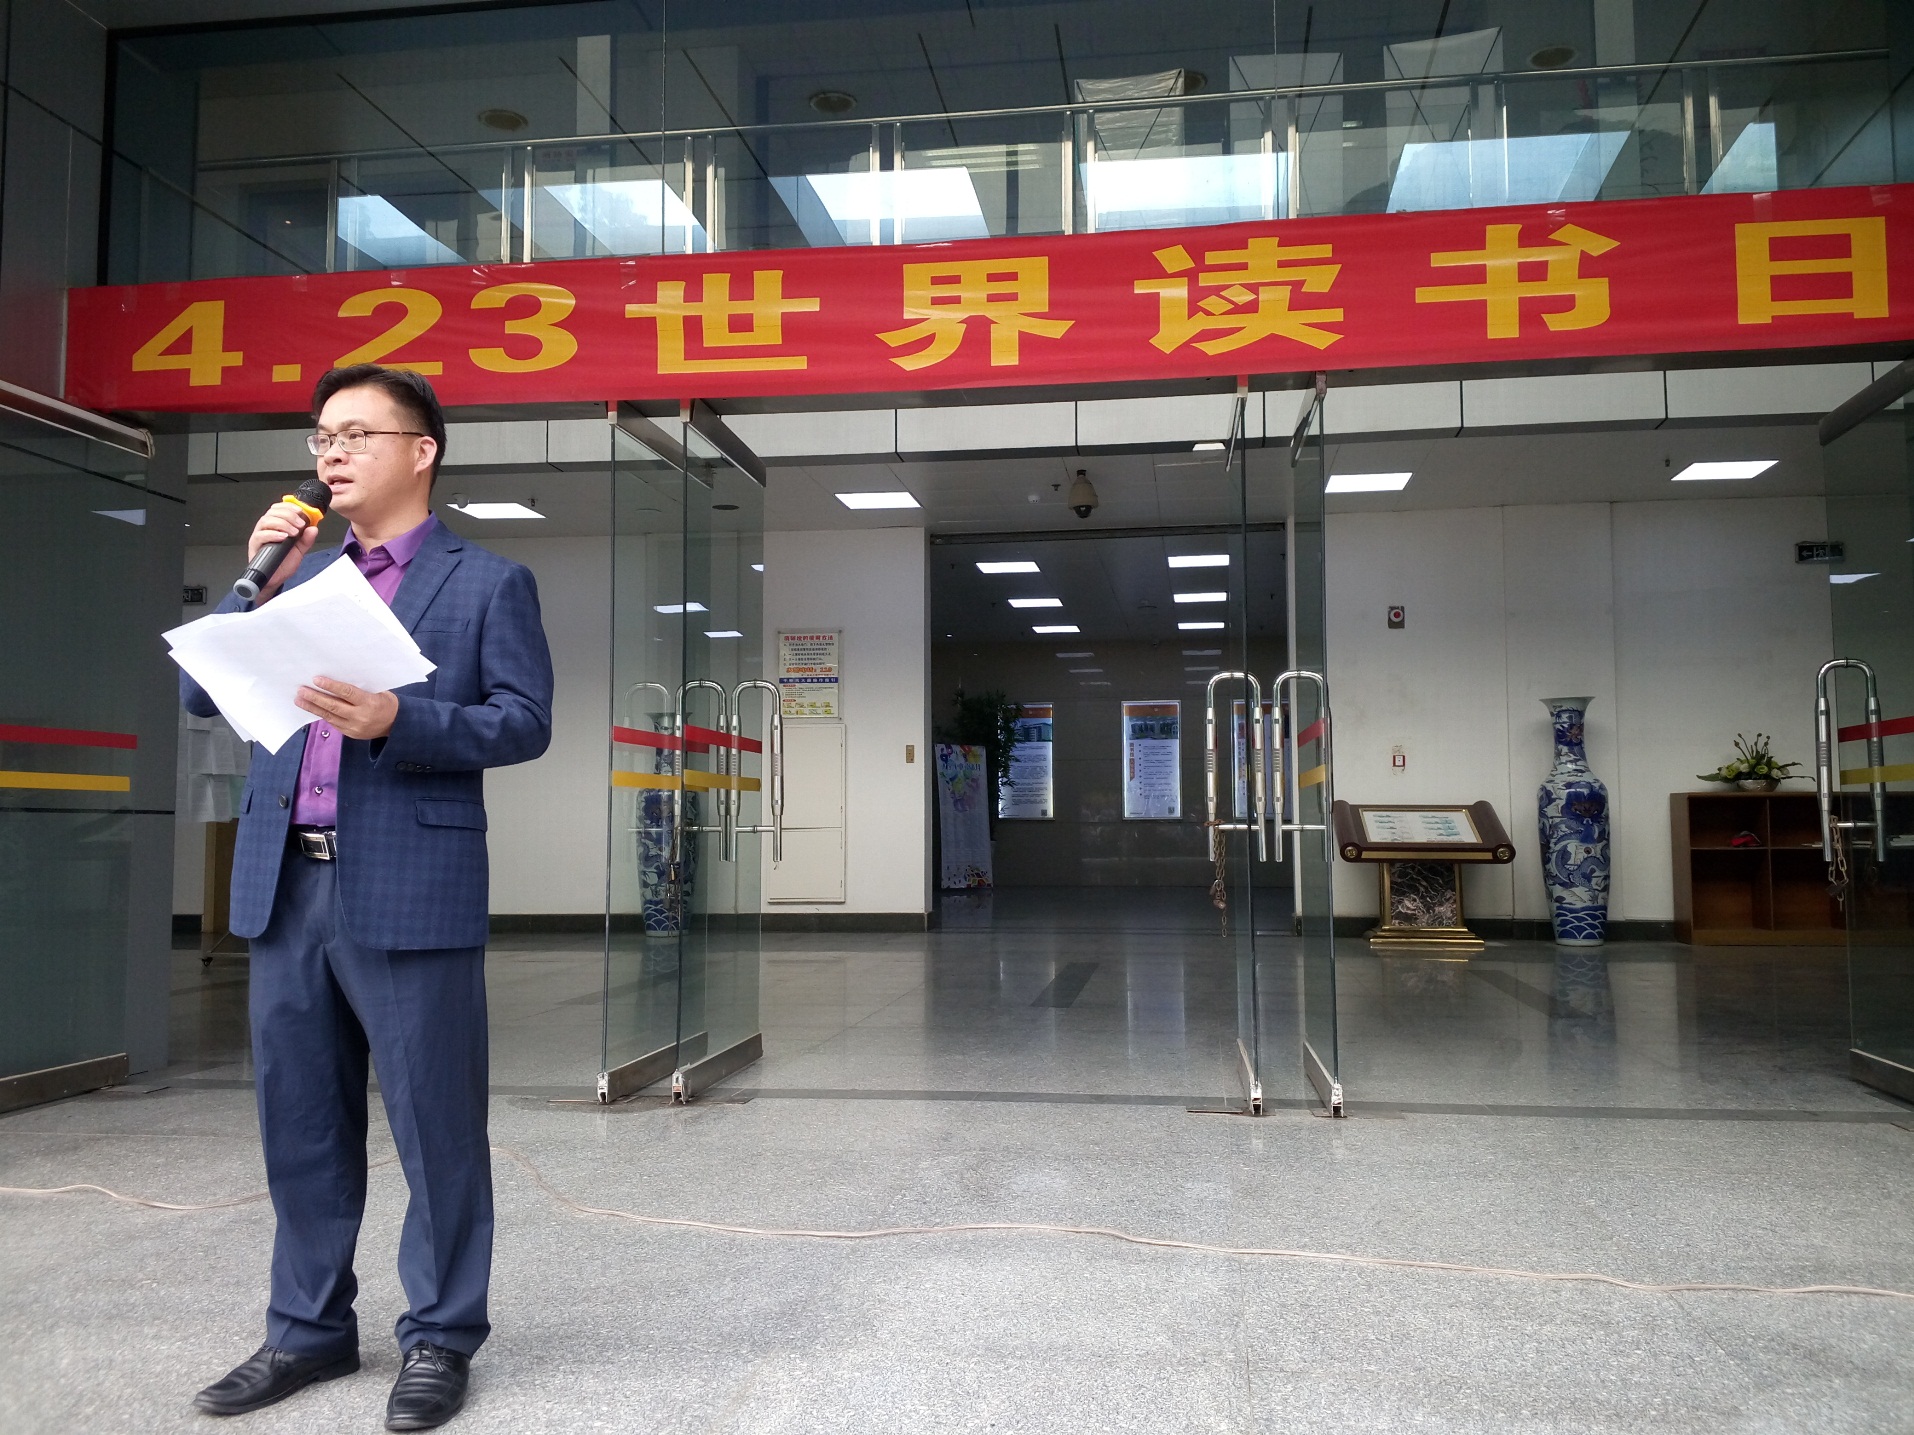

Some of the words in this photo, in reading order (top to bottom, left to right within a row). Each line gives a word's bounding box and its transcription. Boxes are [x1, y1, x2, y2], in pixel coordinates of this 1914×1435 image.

[131, 217, 1890, 387] 4.23世界读书日
